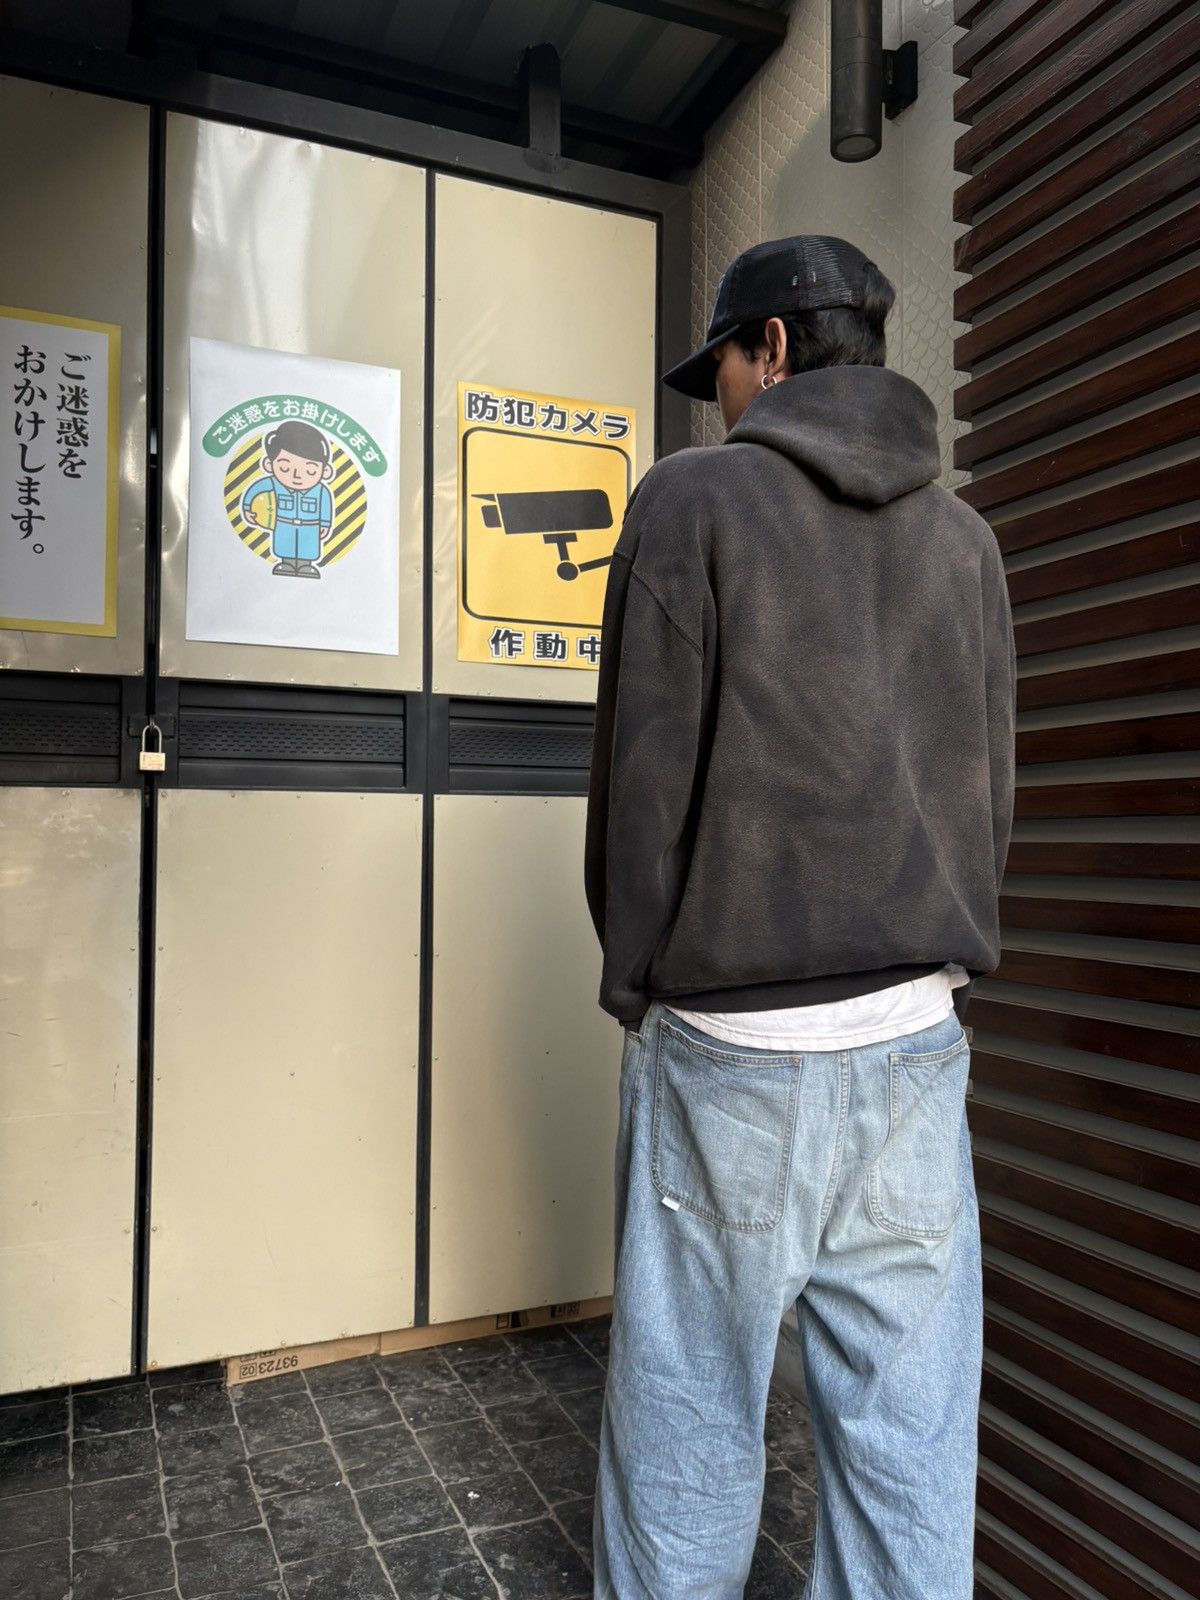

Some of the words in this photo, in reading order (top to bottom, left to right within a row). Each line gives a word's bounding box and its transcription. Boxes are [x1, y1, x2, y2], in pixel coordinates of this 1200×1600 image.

[56, 352, 92, 479] ご迷惑を
[212, 398, 381, 463] ご迷惑をお掛けします
[465, 391, 631, 439] 防犯カメラ
[11, 344, 47, 555] おかけします。
[241, 1365, 256, 1377] 02
[258, 1355, 299, 1375] 93723
